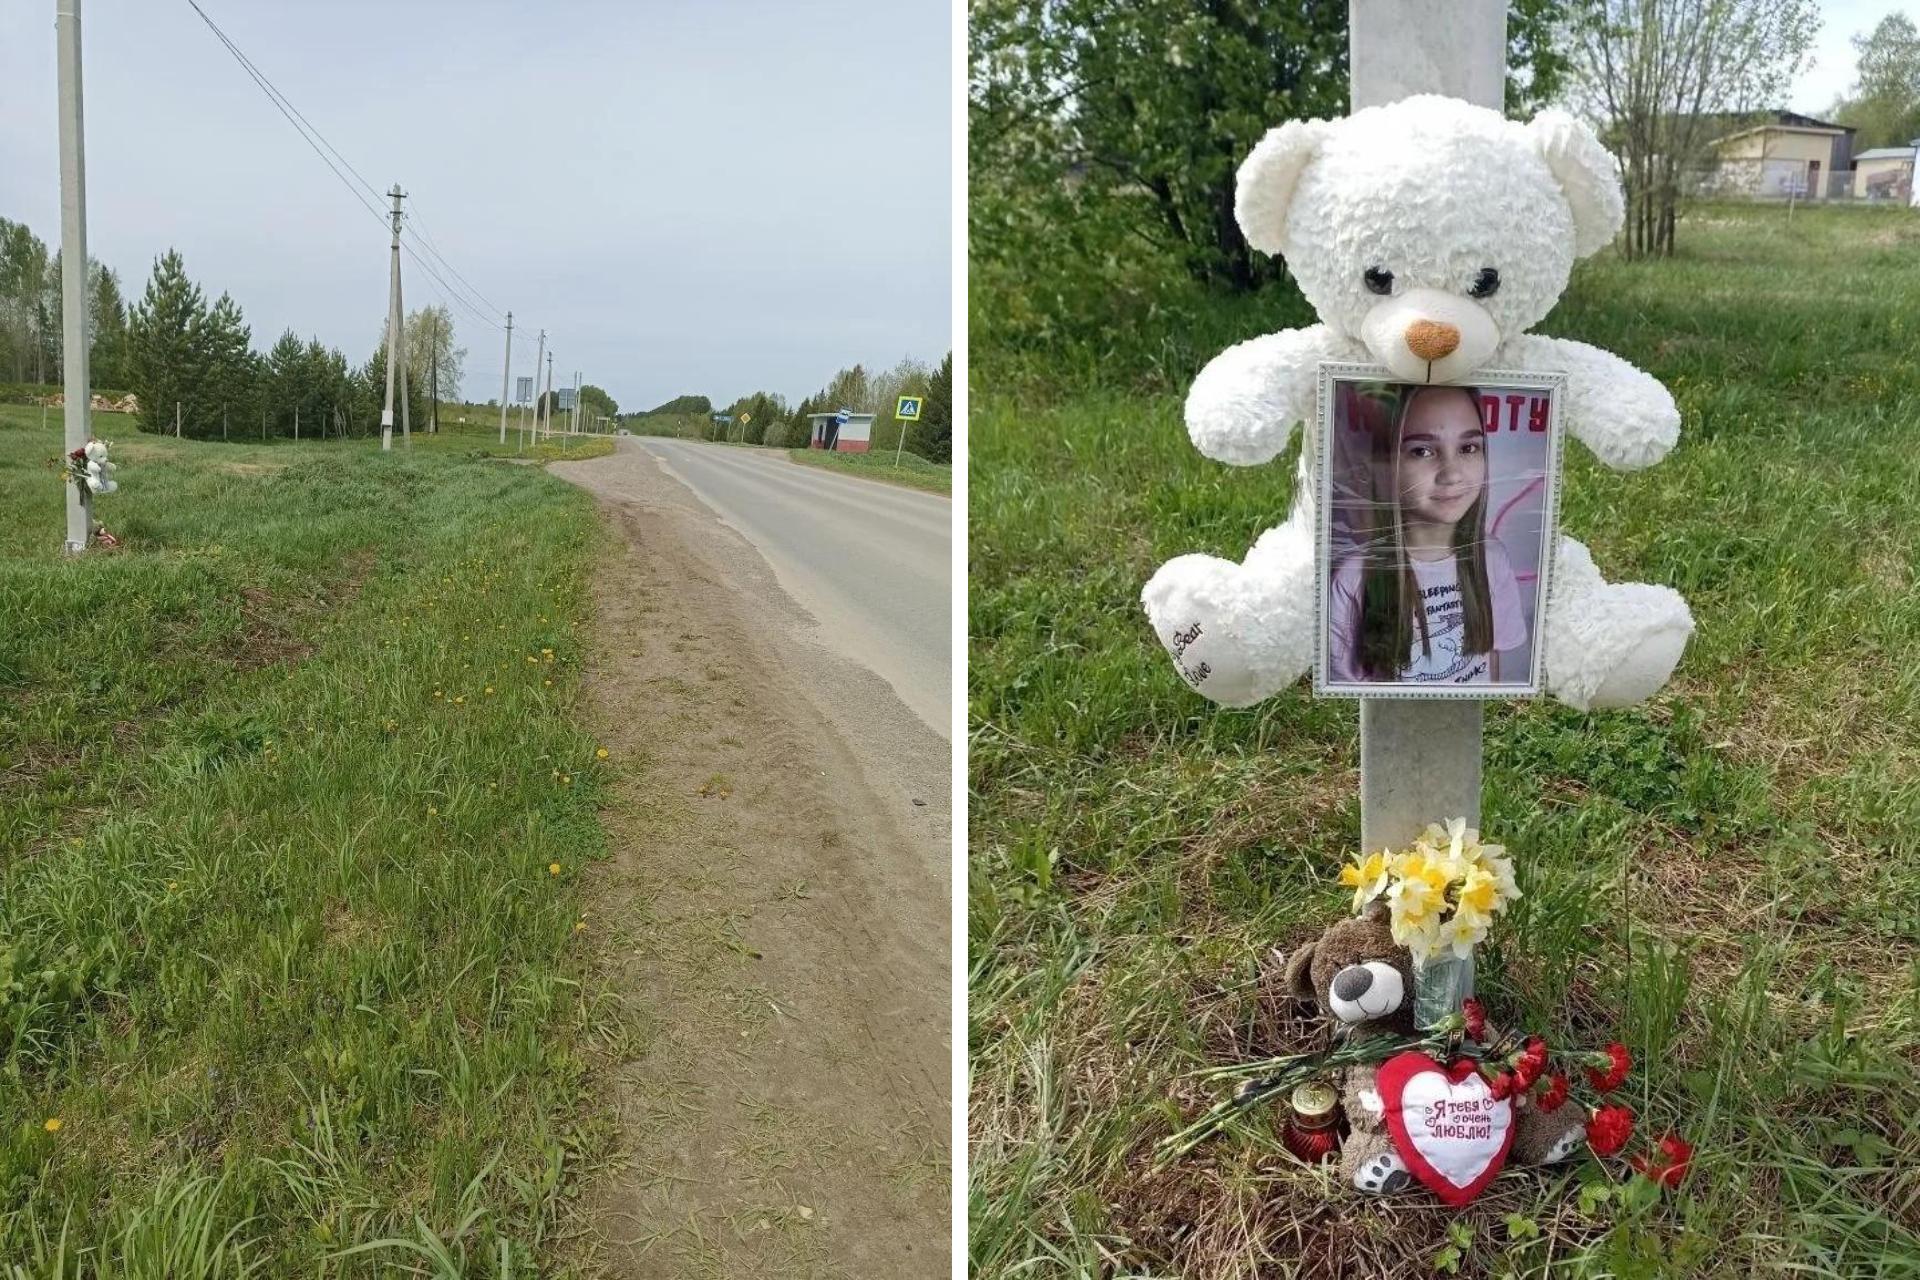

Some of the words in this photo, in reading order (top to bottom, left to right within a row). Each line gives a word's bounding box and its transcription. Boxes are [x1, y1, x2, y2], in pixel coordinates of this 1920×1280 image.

[1434, 1099, 1446, 1119] Я
[1462, 1115, 1491, 1124] очень
[1432, 1125, 1491, 1139] ЛЮБЛЮ!
